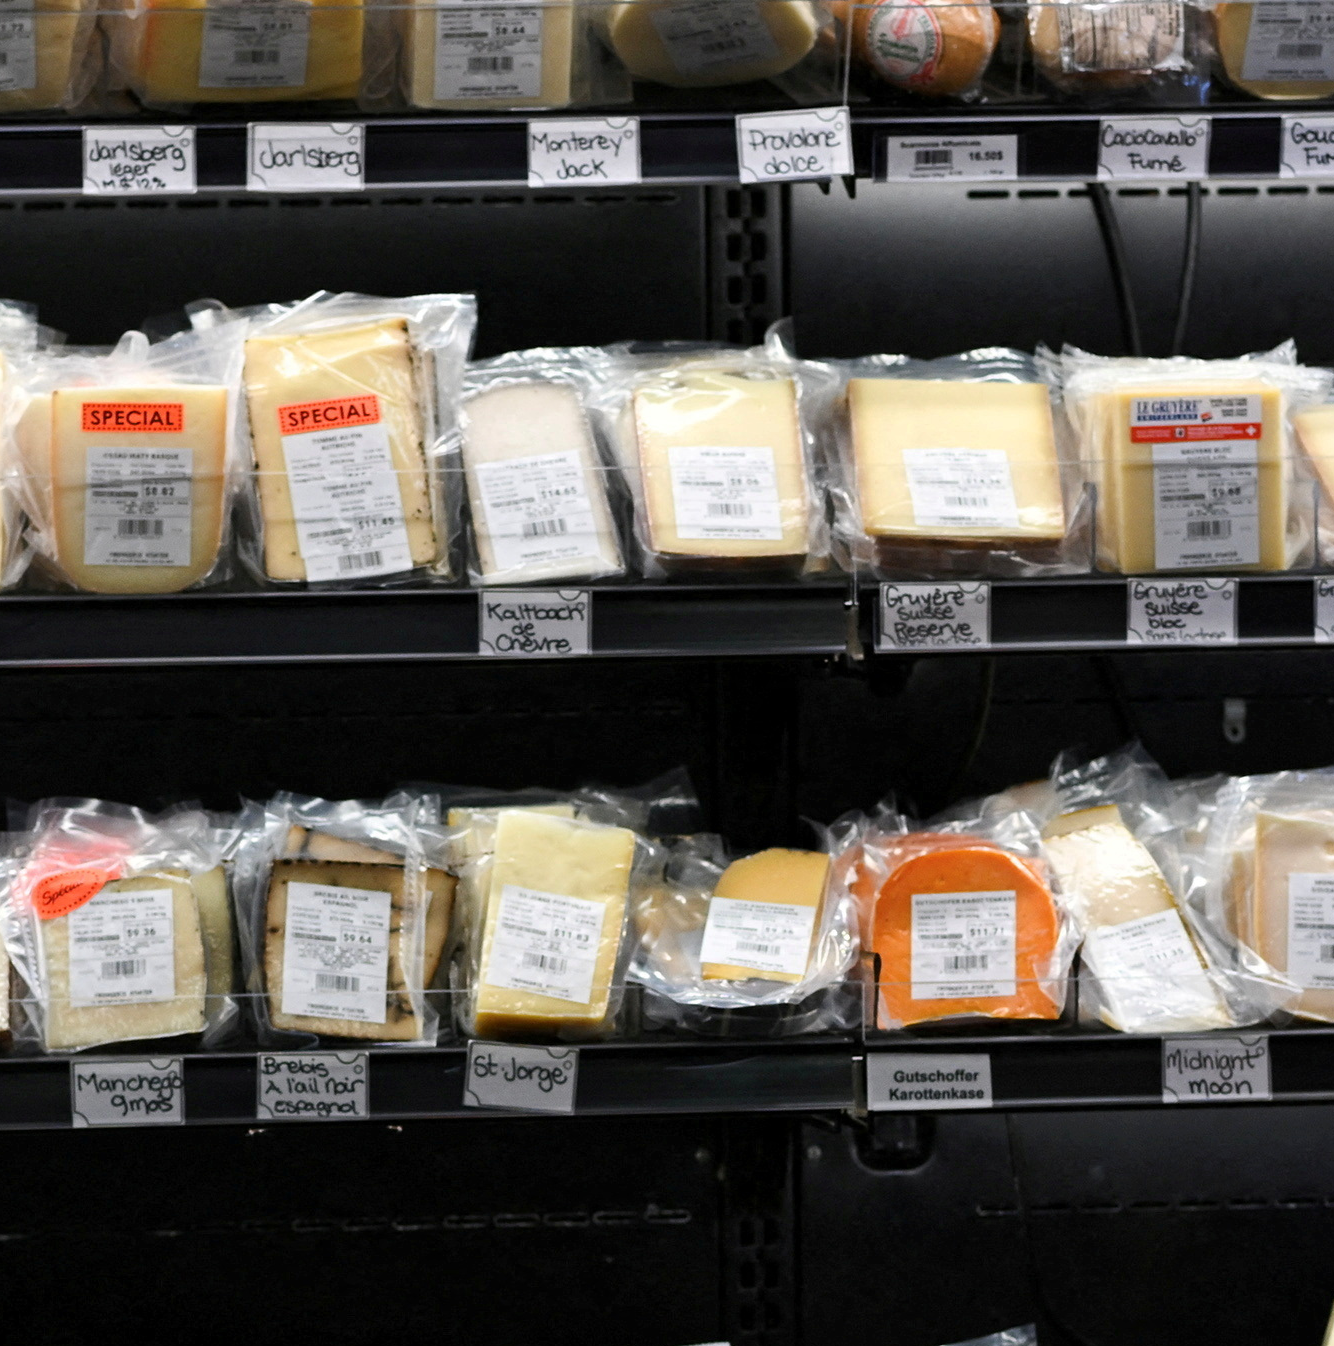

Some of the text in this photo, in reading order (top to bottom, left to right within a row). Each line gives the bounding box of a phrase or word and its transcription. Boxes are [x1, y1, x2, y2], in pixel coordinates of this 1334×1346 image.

[531, 132, 624, 158] Monterey
[88, 140, 187, 172] Jarlsberg
[259, 142, 362, 174] Jarlsberg
[763, 154, 825, 175] dolce
[968, 150, 1004, 162] 16.50$
[1128, 151, 1186, 173] Fumé
[556, 156, 610, 179] Jack
[287, 402, 372, 428] SPECIAL
[1136, 397, 1199, 414] LE GRUYÈRE
[90, 409, 175, 428] SPECIAL
[886, 587, 966, 608] Gruyère
[1135, 582, 1208, 601] Gruyère
[512, 621, 536, 637] de
[1147, 614, 1187, 629] bloc
[262, 1057, 329, 1077] Brebis
[504, 1057, 568, 1093] Jorge
[892, 1068, 980, 1086] Gutschoffer
[77, 1071, 185, 1100] Manchego
[325, 1077, 364, 1095] noir
[888, 1086, 985, 1102] Karottenkase
[273, 1100, 359, 1118] espagnol
